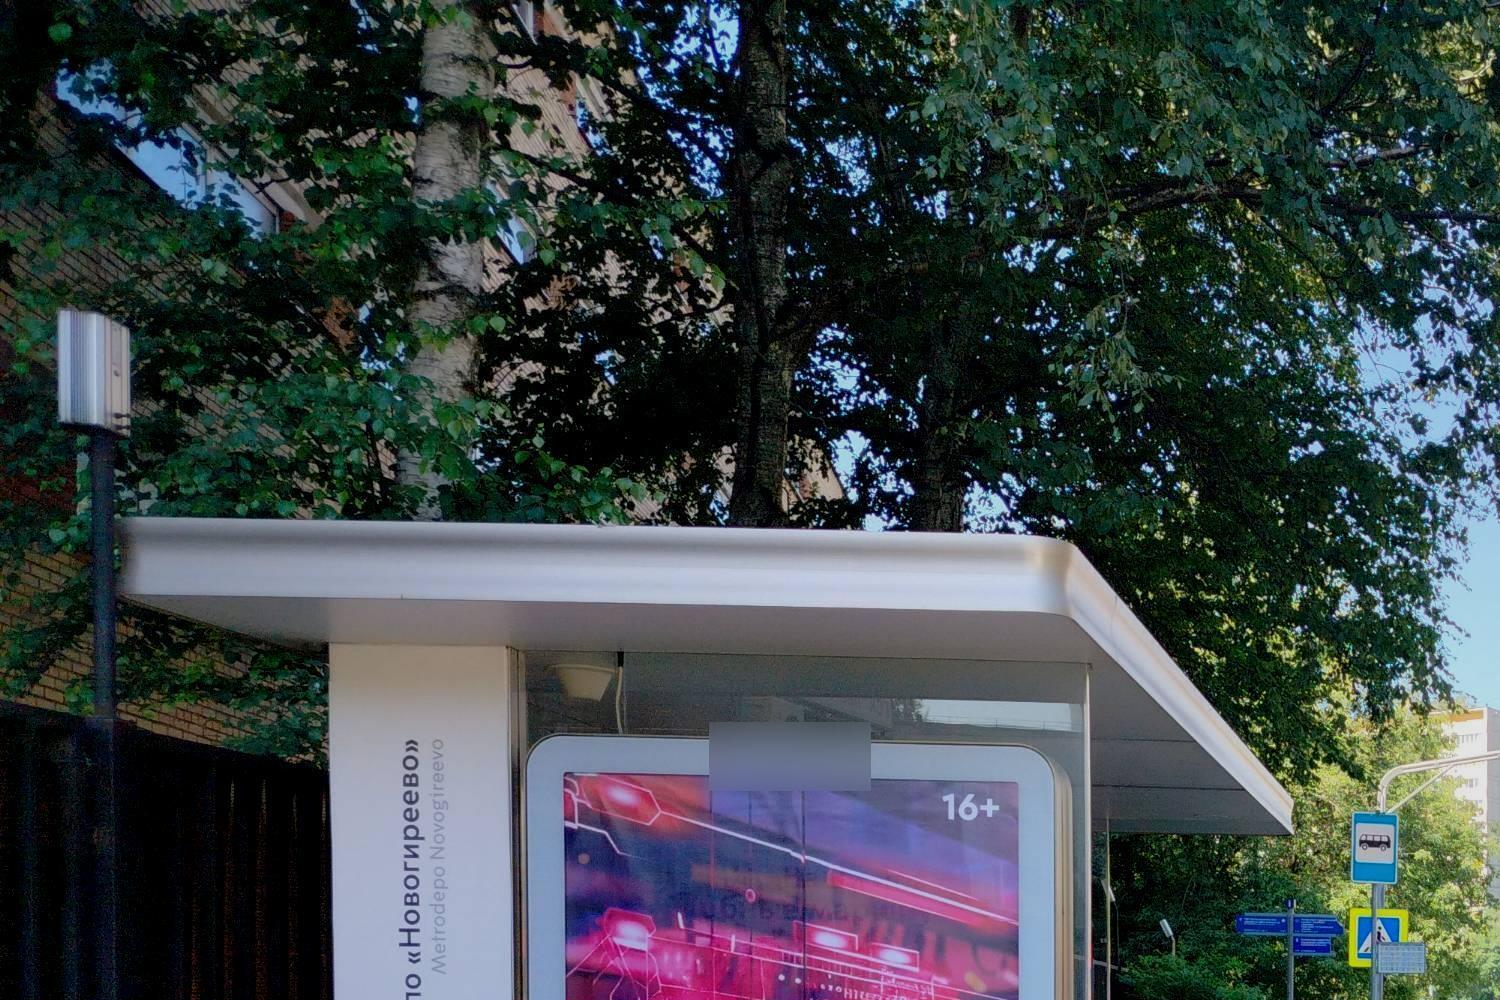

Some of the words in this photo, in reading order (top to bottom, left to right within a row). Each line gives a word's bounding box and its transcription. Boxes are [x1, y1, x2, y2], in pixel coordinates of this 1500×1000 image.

[398, 738, 425, 965] «Новогиреево»
[429, 738, 449, 860] Novogireevo
[942, 793, 1000, 820] 16+
[429, 866, 449, 974] Metrodepo
